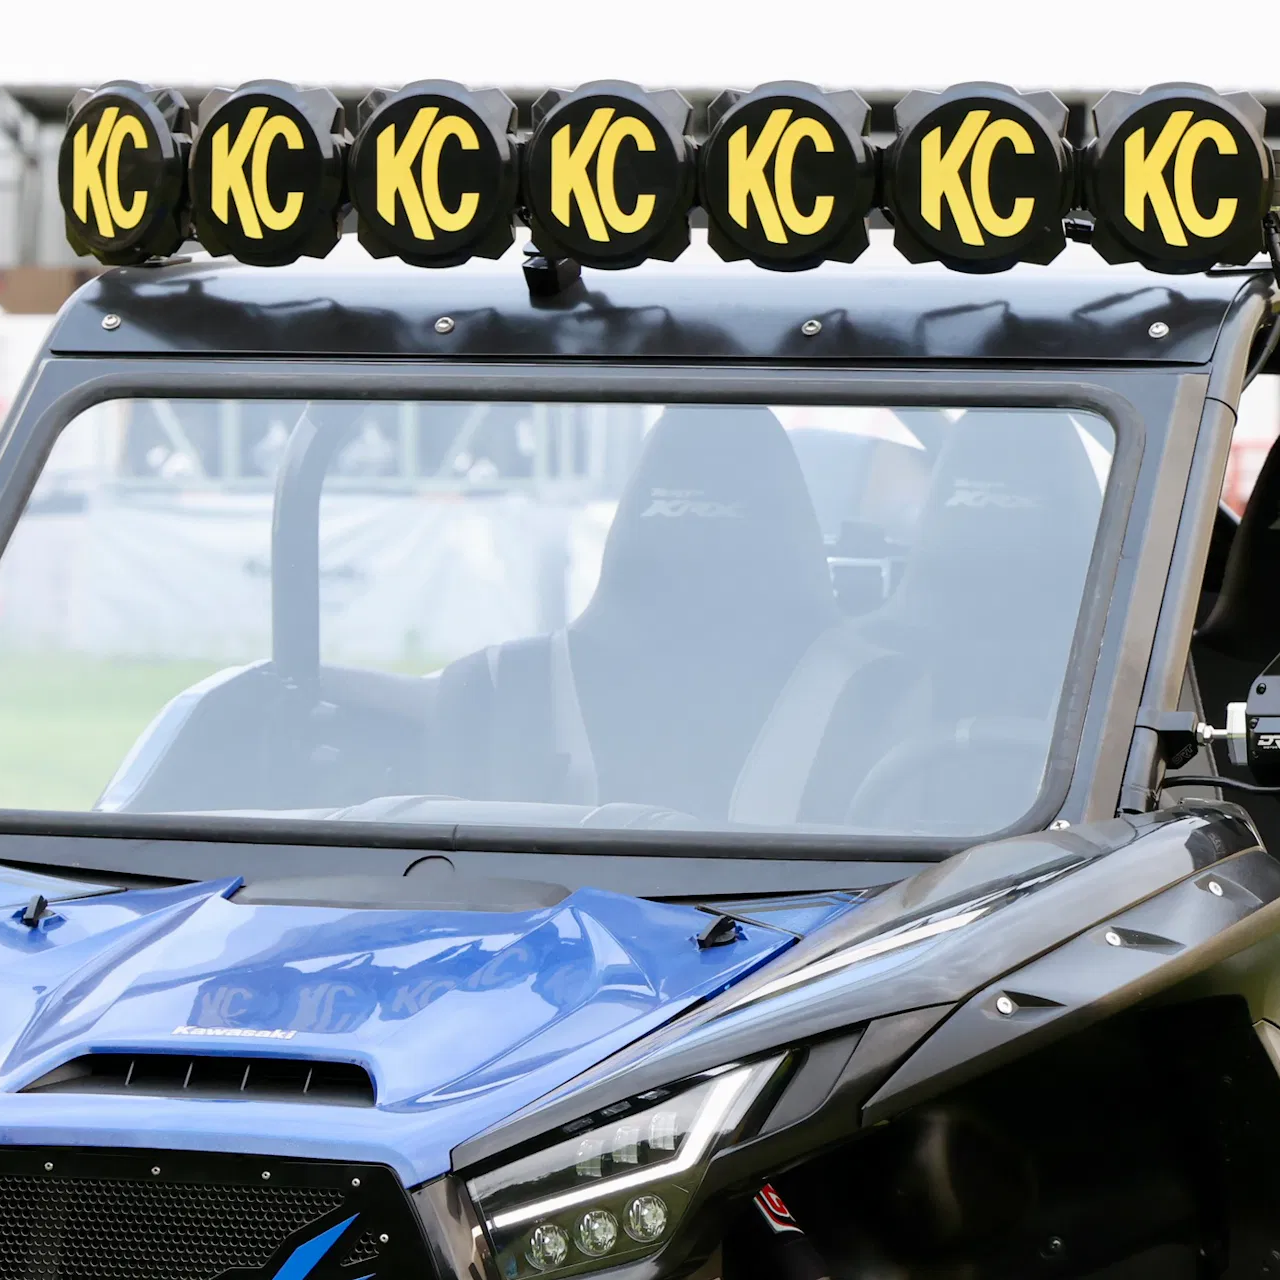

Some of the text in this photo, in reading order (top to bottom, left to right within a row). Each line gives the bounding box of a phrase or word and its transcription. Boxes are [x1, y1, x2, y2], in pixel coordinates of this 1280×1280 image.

[73, 106, 148, 238] KC
[211, 106, 304, 240] KC
[376, 106, 480, 241] KC
[551, 107, 656, 242] KC
[728, 108, 835, 244] KC
[921, 110, 1035, 246] KC
[1124, 111, 1239, 247] KC
[170, 1025, 298, 1041] Kawasaki
